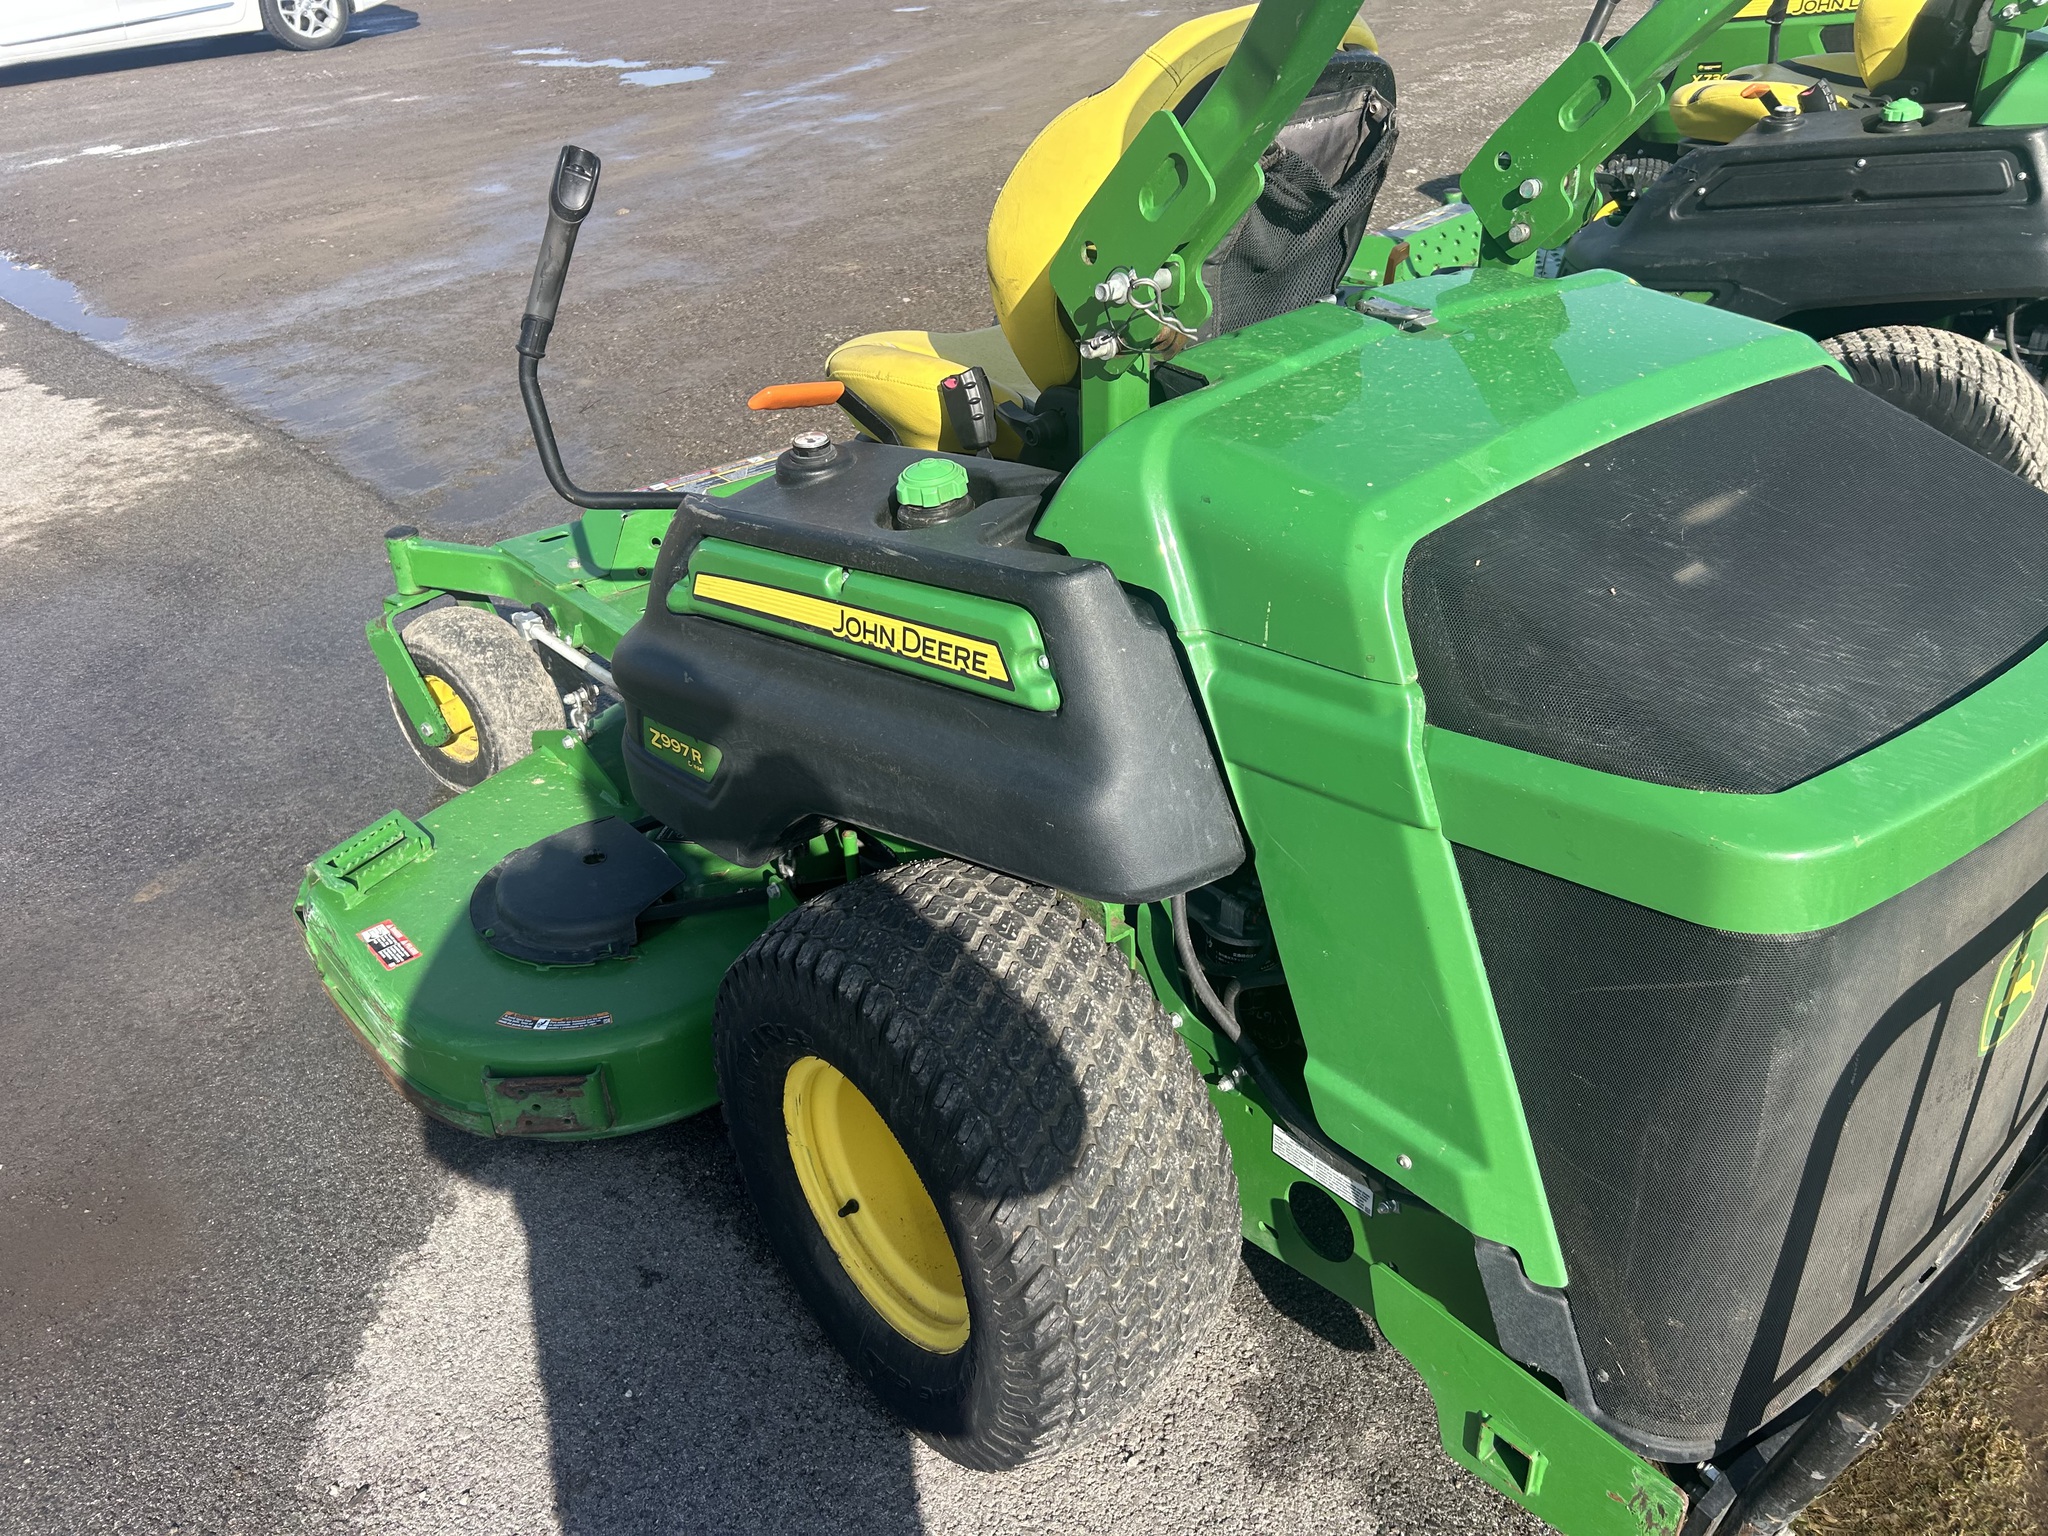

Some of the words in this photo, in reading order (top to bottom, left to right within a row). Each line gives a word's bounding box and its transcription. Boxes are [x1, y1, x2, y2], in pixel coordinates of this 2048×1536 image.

[1792, 0, 1844, 14] JOHN
[833, 609, 895, 649] JOHN
[902, 626, 988, 675] DEERE
[649, 727, 703, 765] Z997R
